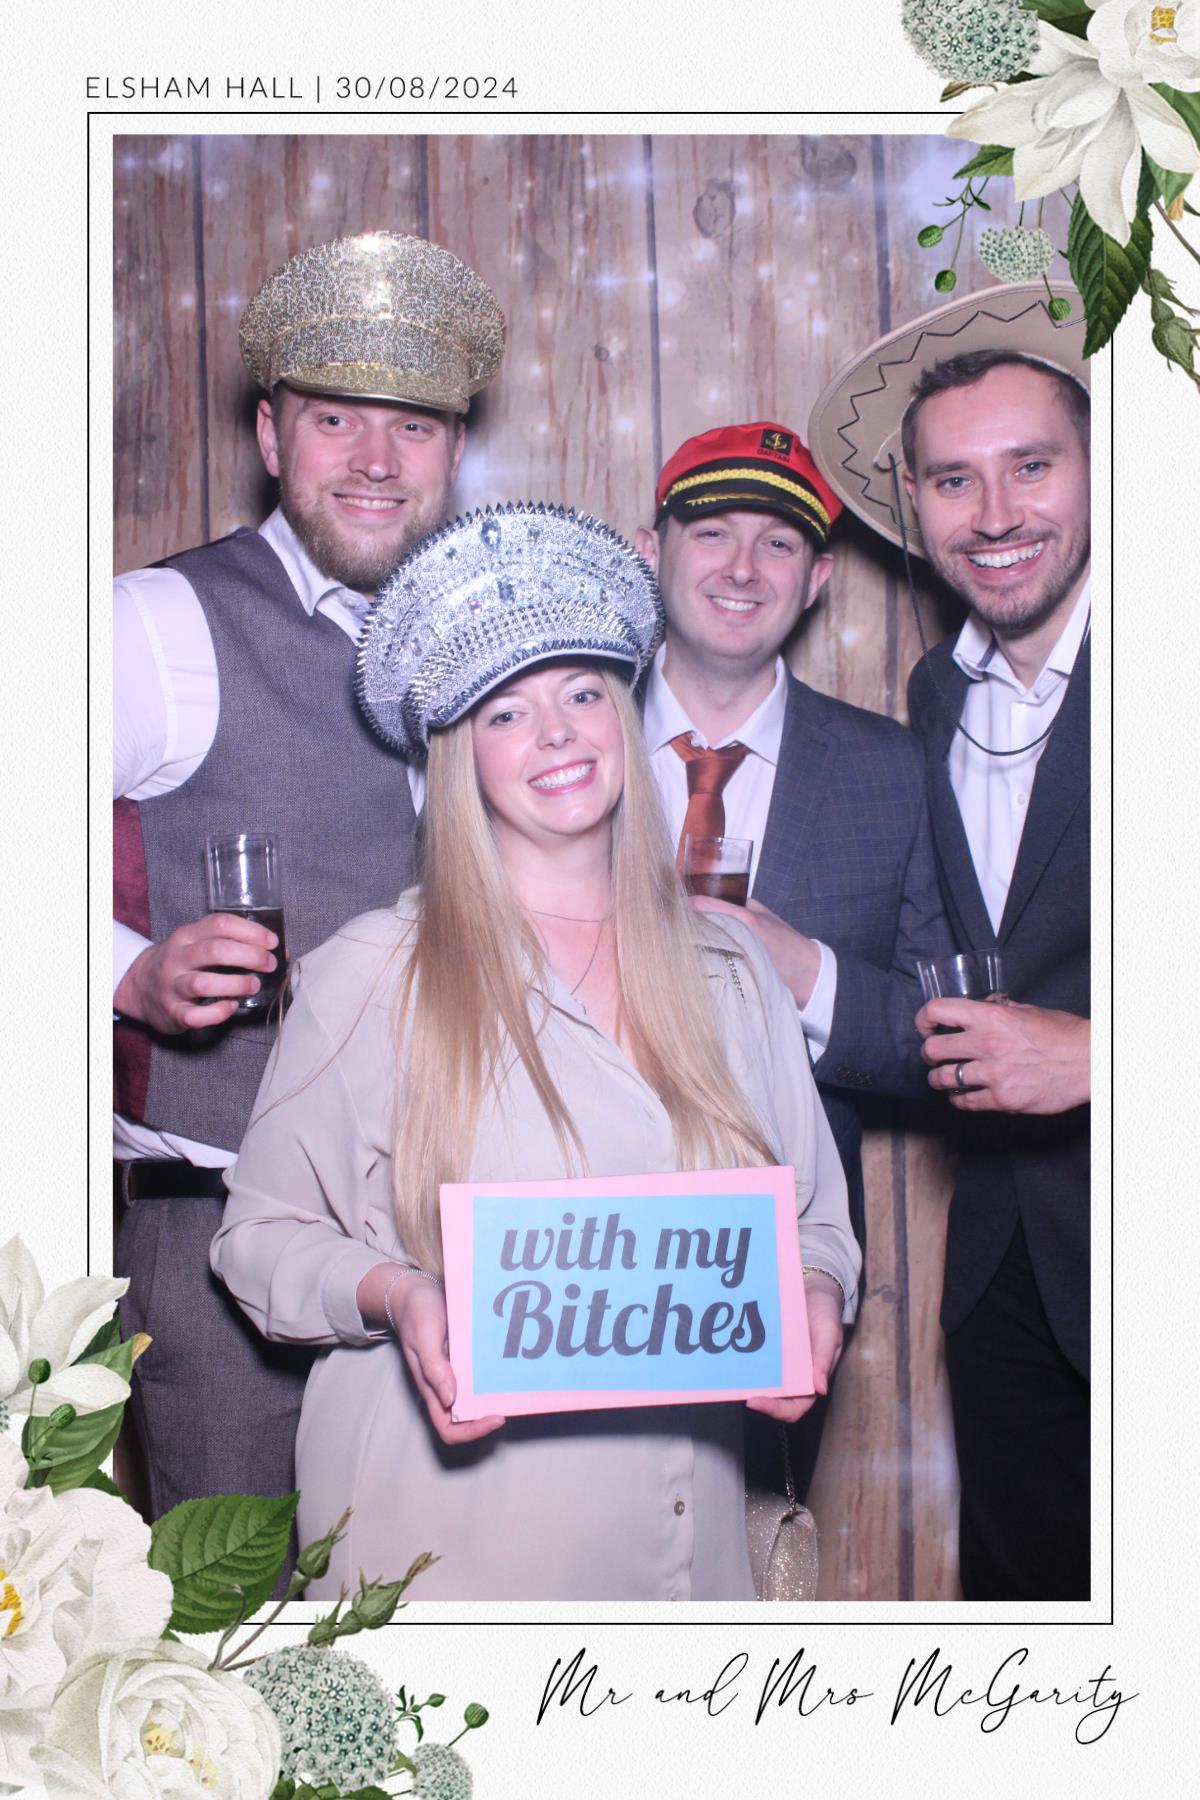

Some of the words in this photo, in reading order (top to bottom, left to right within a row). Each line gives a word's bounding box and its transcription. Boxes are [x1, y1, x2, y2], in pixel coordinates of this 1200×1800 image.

[500, 1212, 637, 1271] with
[654, 1228, 751, 1288] my
[493, 1280, 765, 1360] Bitches
